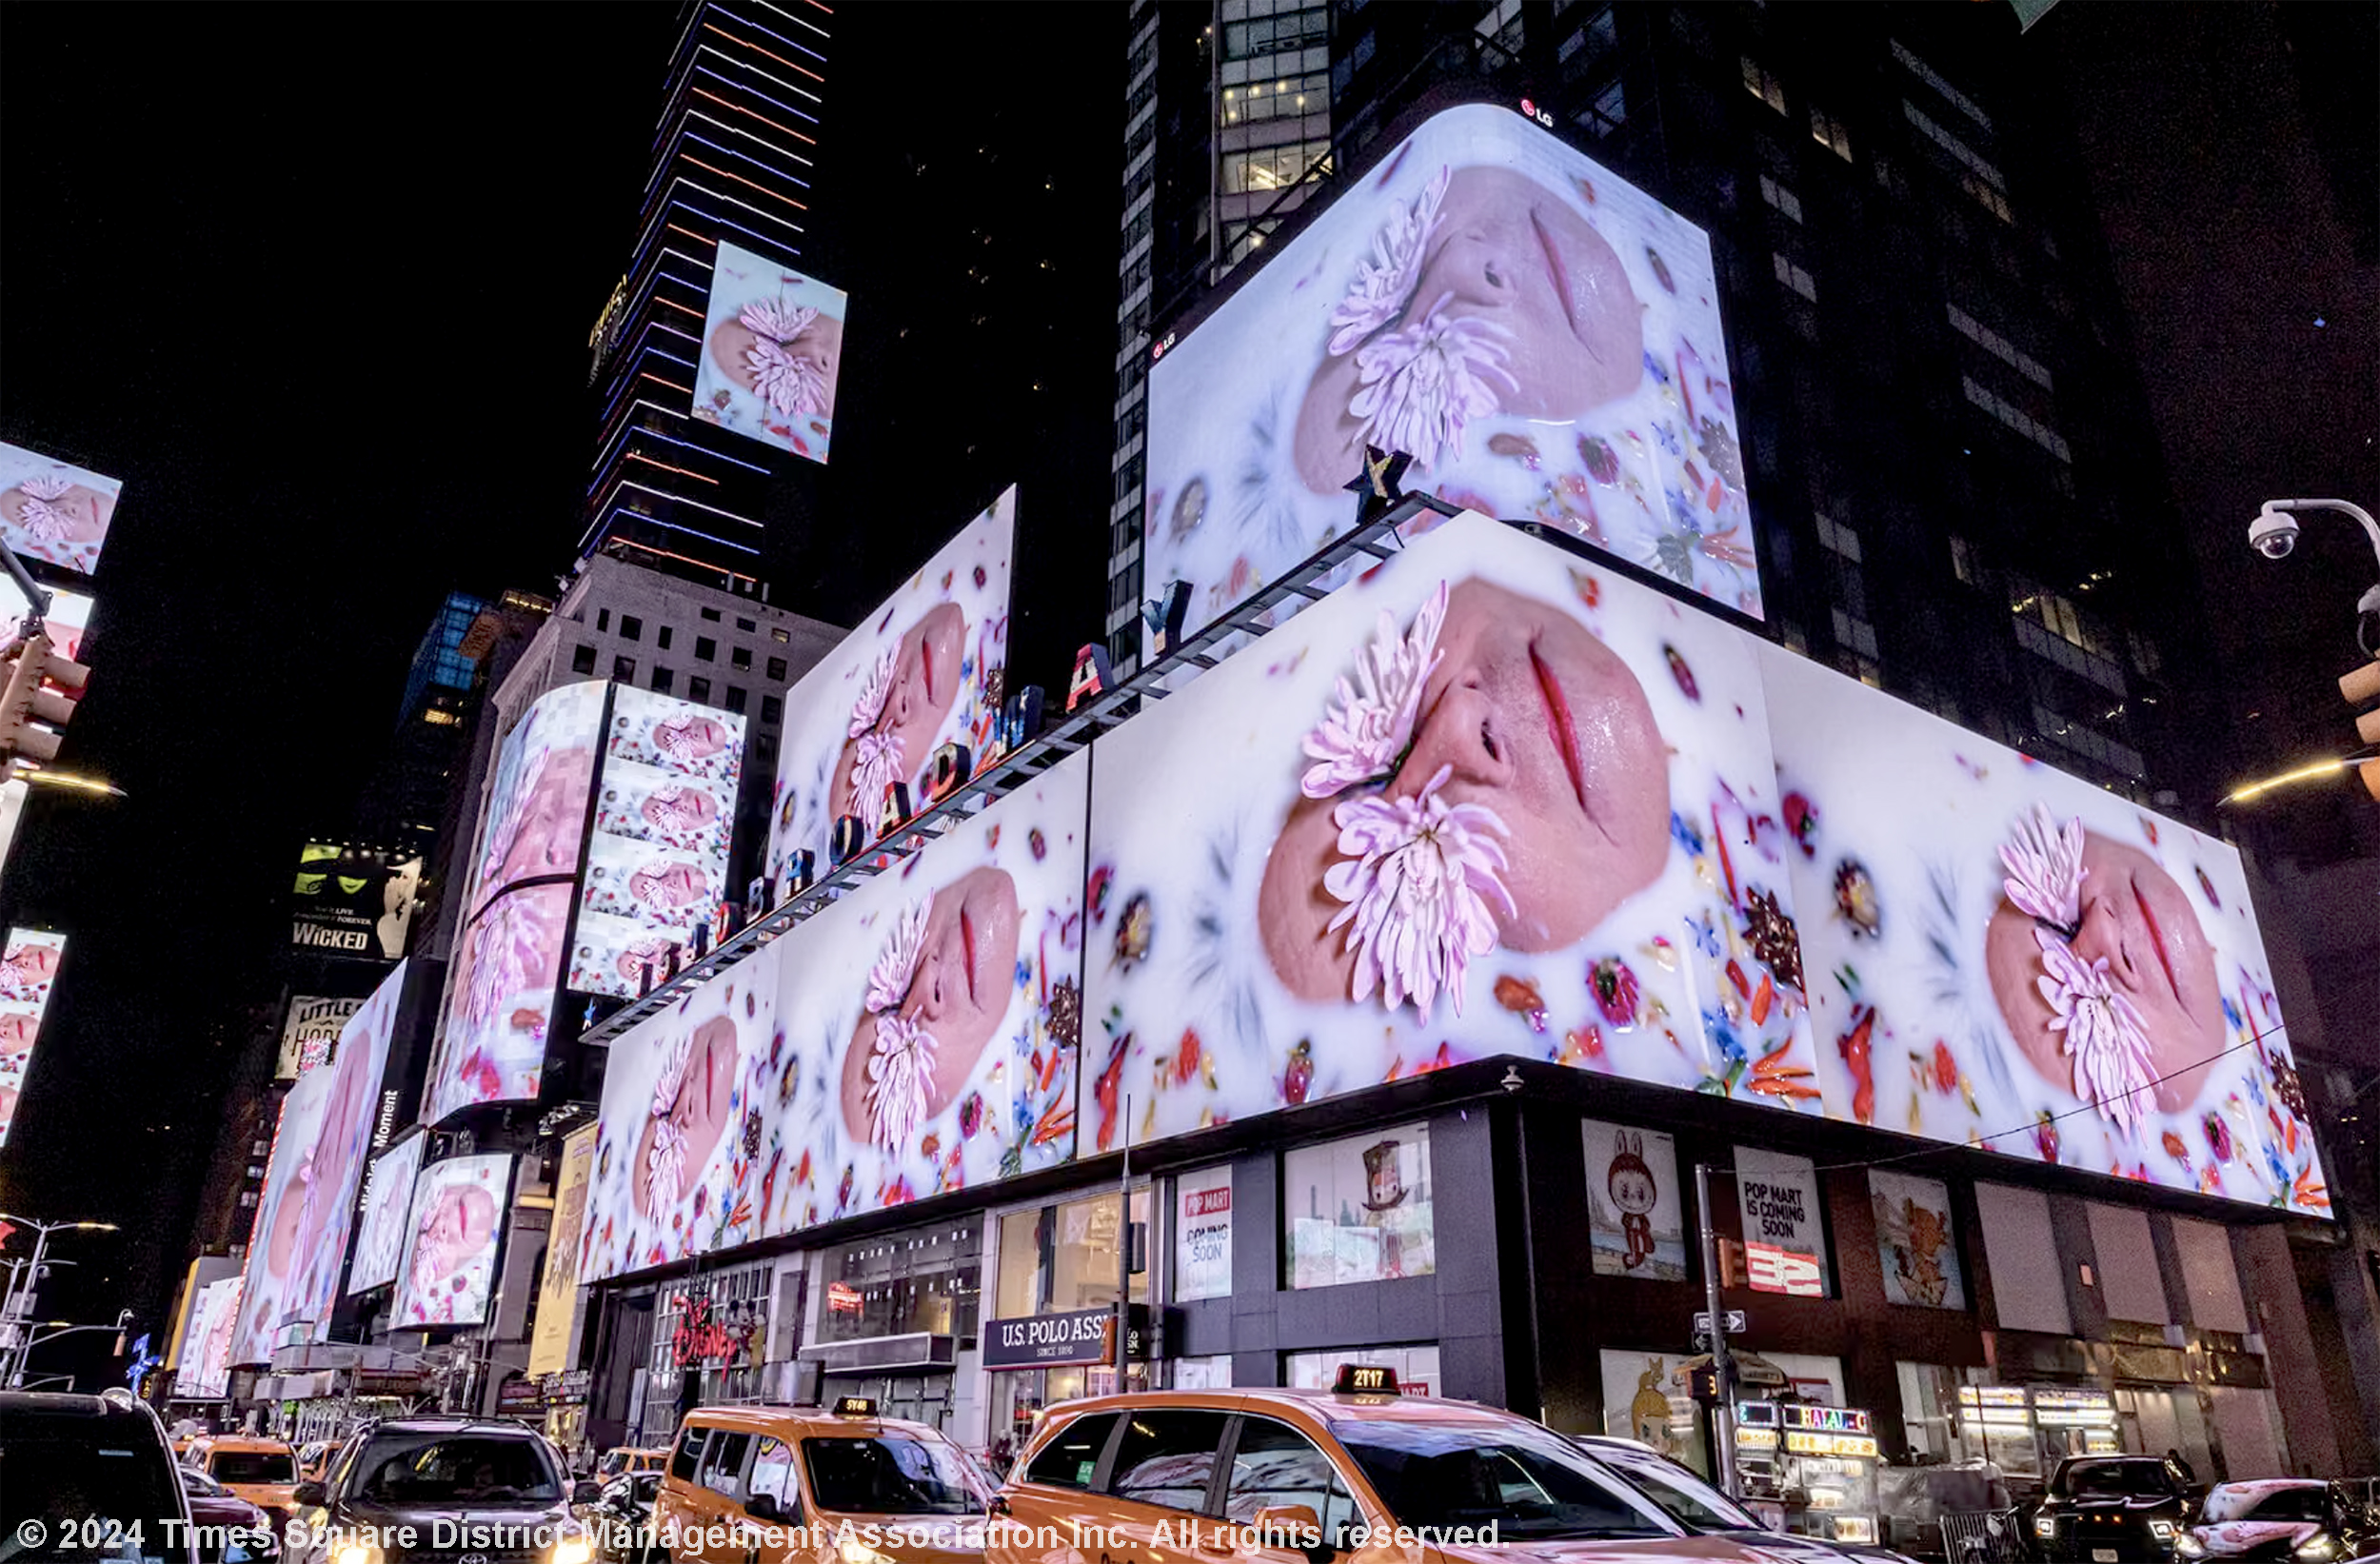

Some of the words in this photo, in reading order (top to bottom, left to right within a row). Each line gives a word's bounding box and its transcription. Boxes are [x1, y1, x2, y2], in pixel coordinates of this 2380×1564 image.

[1536, 108, 1553, 128] LG
[1163, 332, 1176, 350] LG
[299, 1001, 353, 1023] LITTLE
[373, 1090, 398, 1148] Moment
[1187, 1195, 1204, 1215] POP
[1204, 1190, 1229, 1212] MART
[1744, 1181, 1768, 1199] POP
[1771, 1186, 1802, 1207] MART
[1747, 1199, 1758, 1216] IS
[1759, 1201, 1806, 1222] COMING
[1187, 1223, 1229, 1245] COMING
[1762, 1219, 1795, 1238] SOON
[1193, 1242, 1223, 1263] SOON
[1002, 1324, 1025, 1347] U.S.
[1028, 1318, 1069, 1345] POLO
[1354, 1369, 1384, 1388] 2T17
